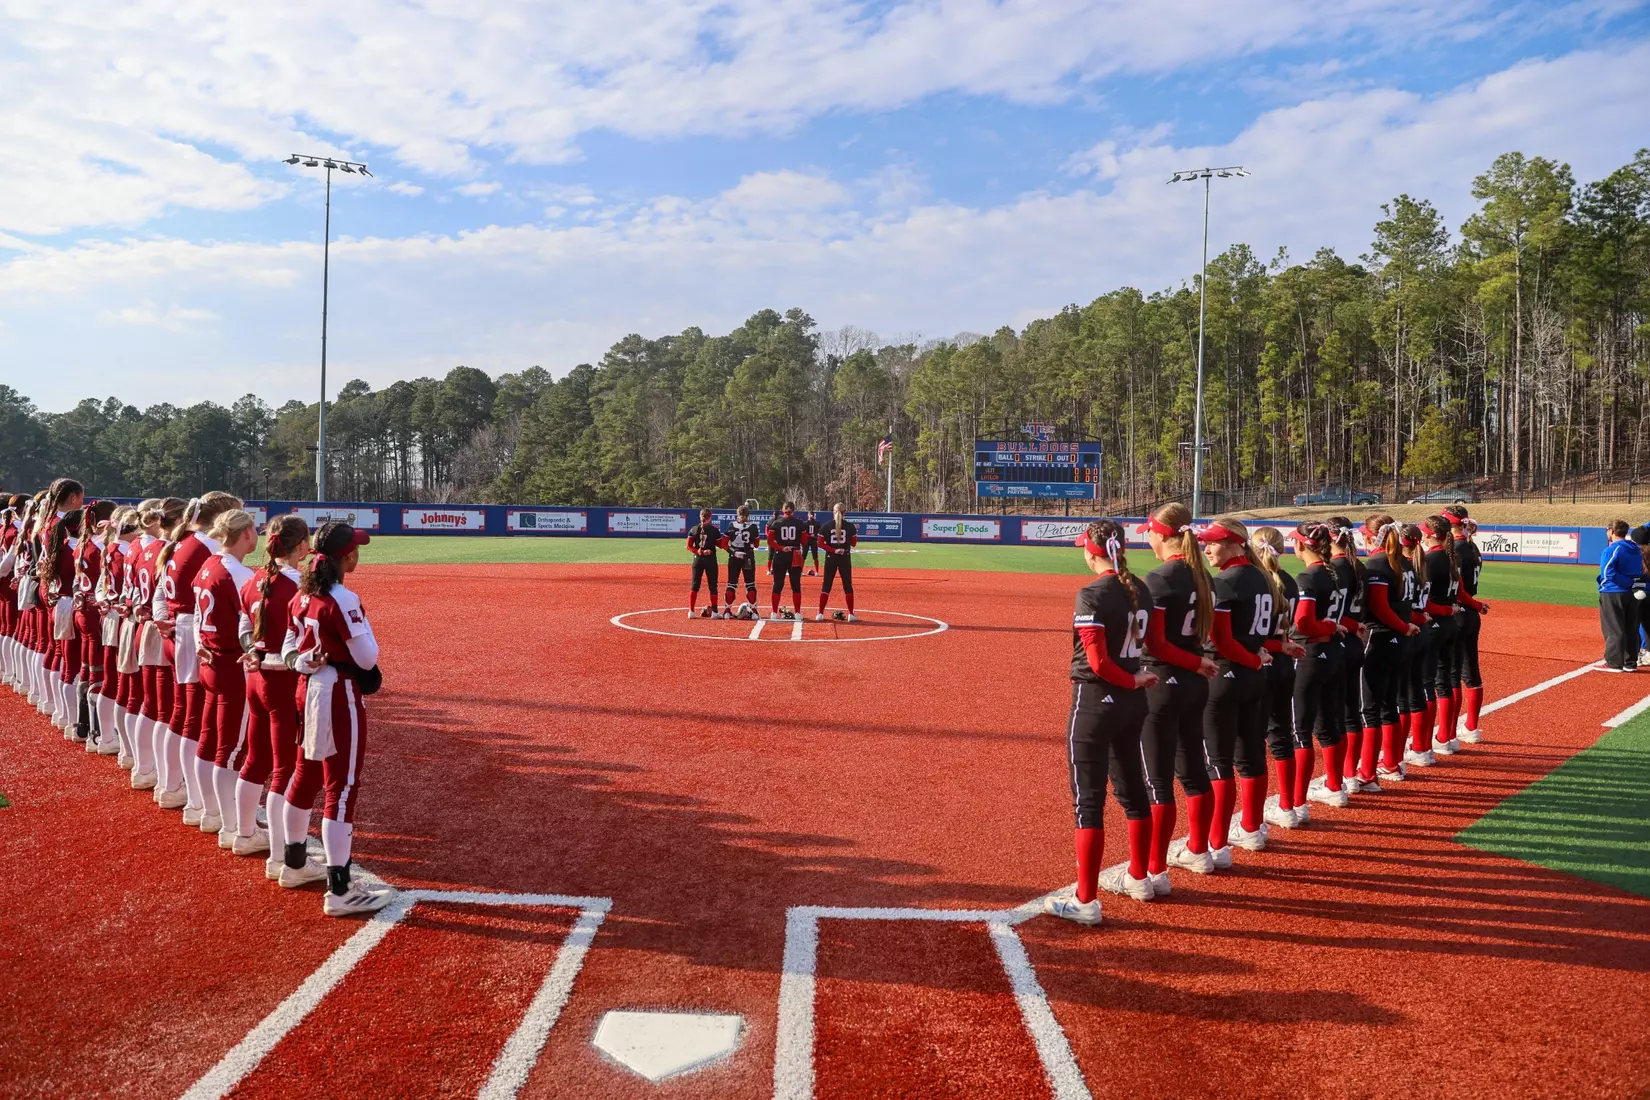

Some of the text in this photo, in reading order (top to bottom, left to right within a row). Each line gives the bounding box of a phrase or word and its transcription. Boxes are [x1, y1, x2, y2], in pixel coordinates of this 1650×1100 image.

[997, 442, 1079, 451] BULLDOGS
[781, 526, 796, 540] 00
[933, 524, 956, 533] Super
[964, 525, 988, 533] Foods
[1481, 541, 1518, 552] TAYLOR
[1248, 593, 1273, 636] 18
[1120, 610, 1148, 658] 12
